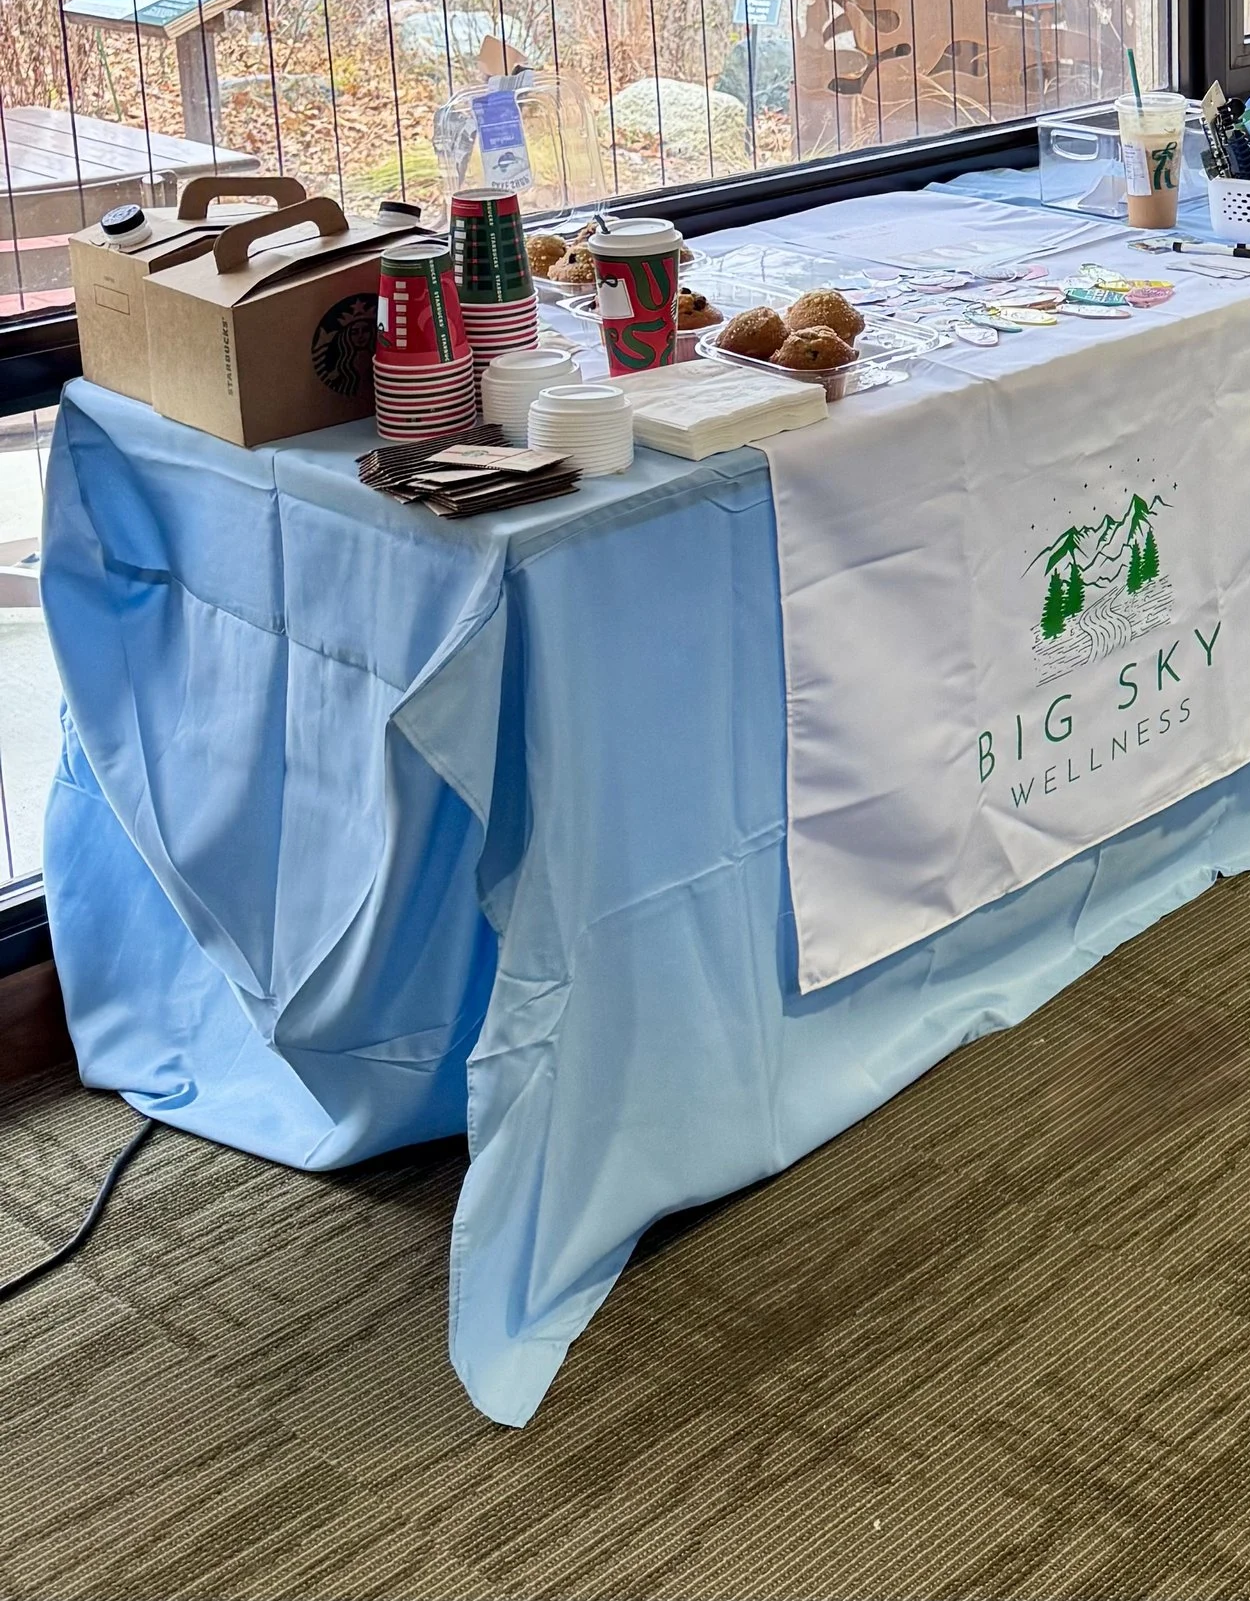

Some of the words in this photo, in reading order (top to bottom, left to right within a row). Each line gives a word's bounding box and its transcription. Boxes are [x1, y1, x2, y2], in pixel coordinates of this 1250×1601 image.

[490, 232, 499, 269] STARBUCKS
[434, 290, 444, 328] STARBUCKS
[221, 317, 234, 397] STARBUCKS
[978, 694, 1072, 783] BIG
[1118, 621, 1221, 710] SKY
[1011, 698, 1191, 808] WELLNESS
